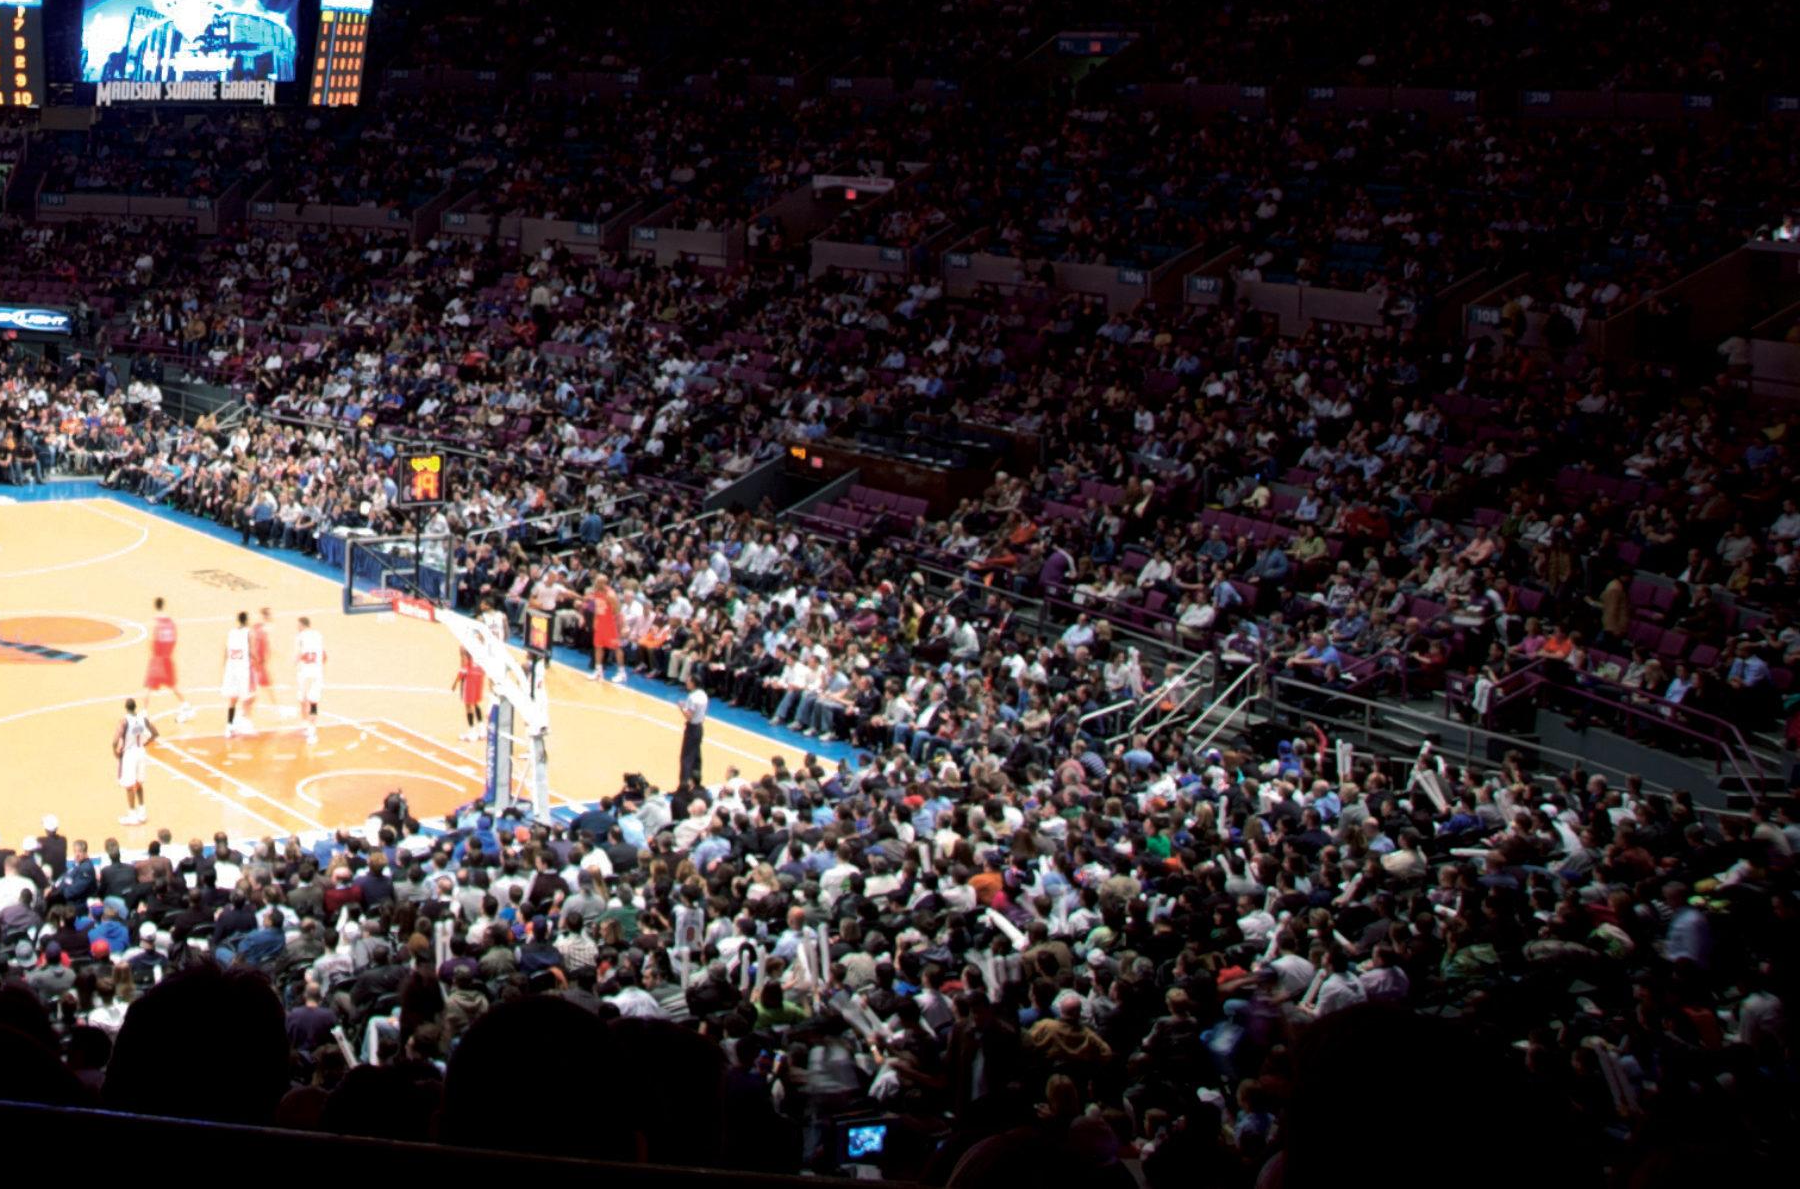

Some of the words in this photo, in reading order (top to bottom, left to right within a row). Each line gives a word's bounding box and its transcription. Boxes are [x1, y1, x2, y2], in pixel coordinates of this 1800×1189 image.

[13, 18, 25, 31] 7
[15, 54, 26, 68] 2
[15, 72, 27, 87] 9
[14, 91, 32, 106] 10
[96, 80, 162, 107] MADISON
[163, 80, 218, 101] SQUARE
[220, 79, 275, 106] GARDEN
